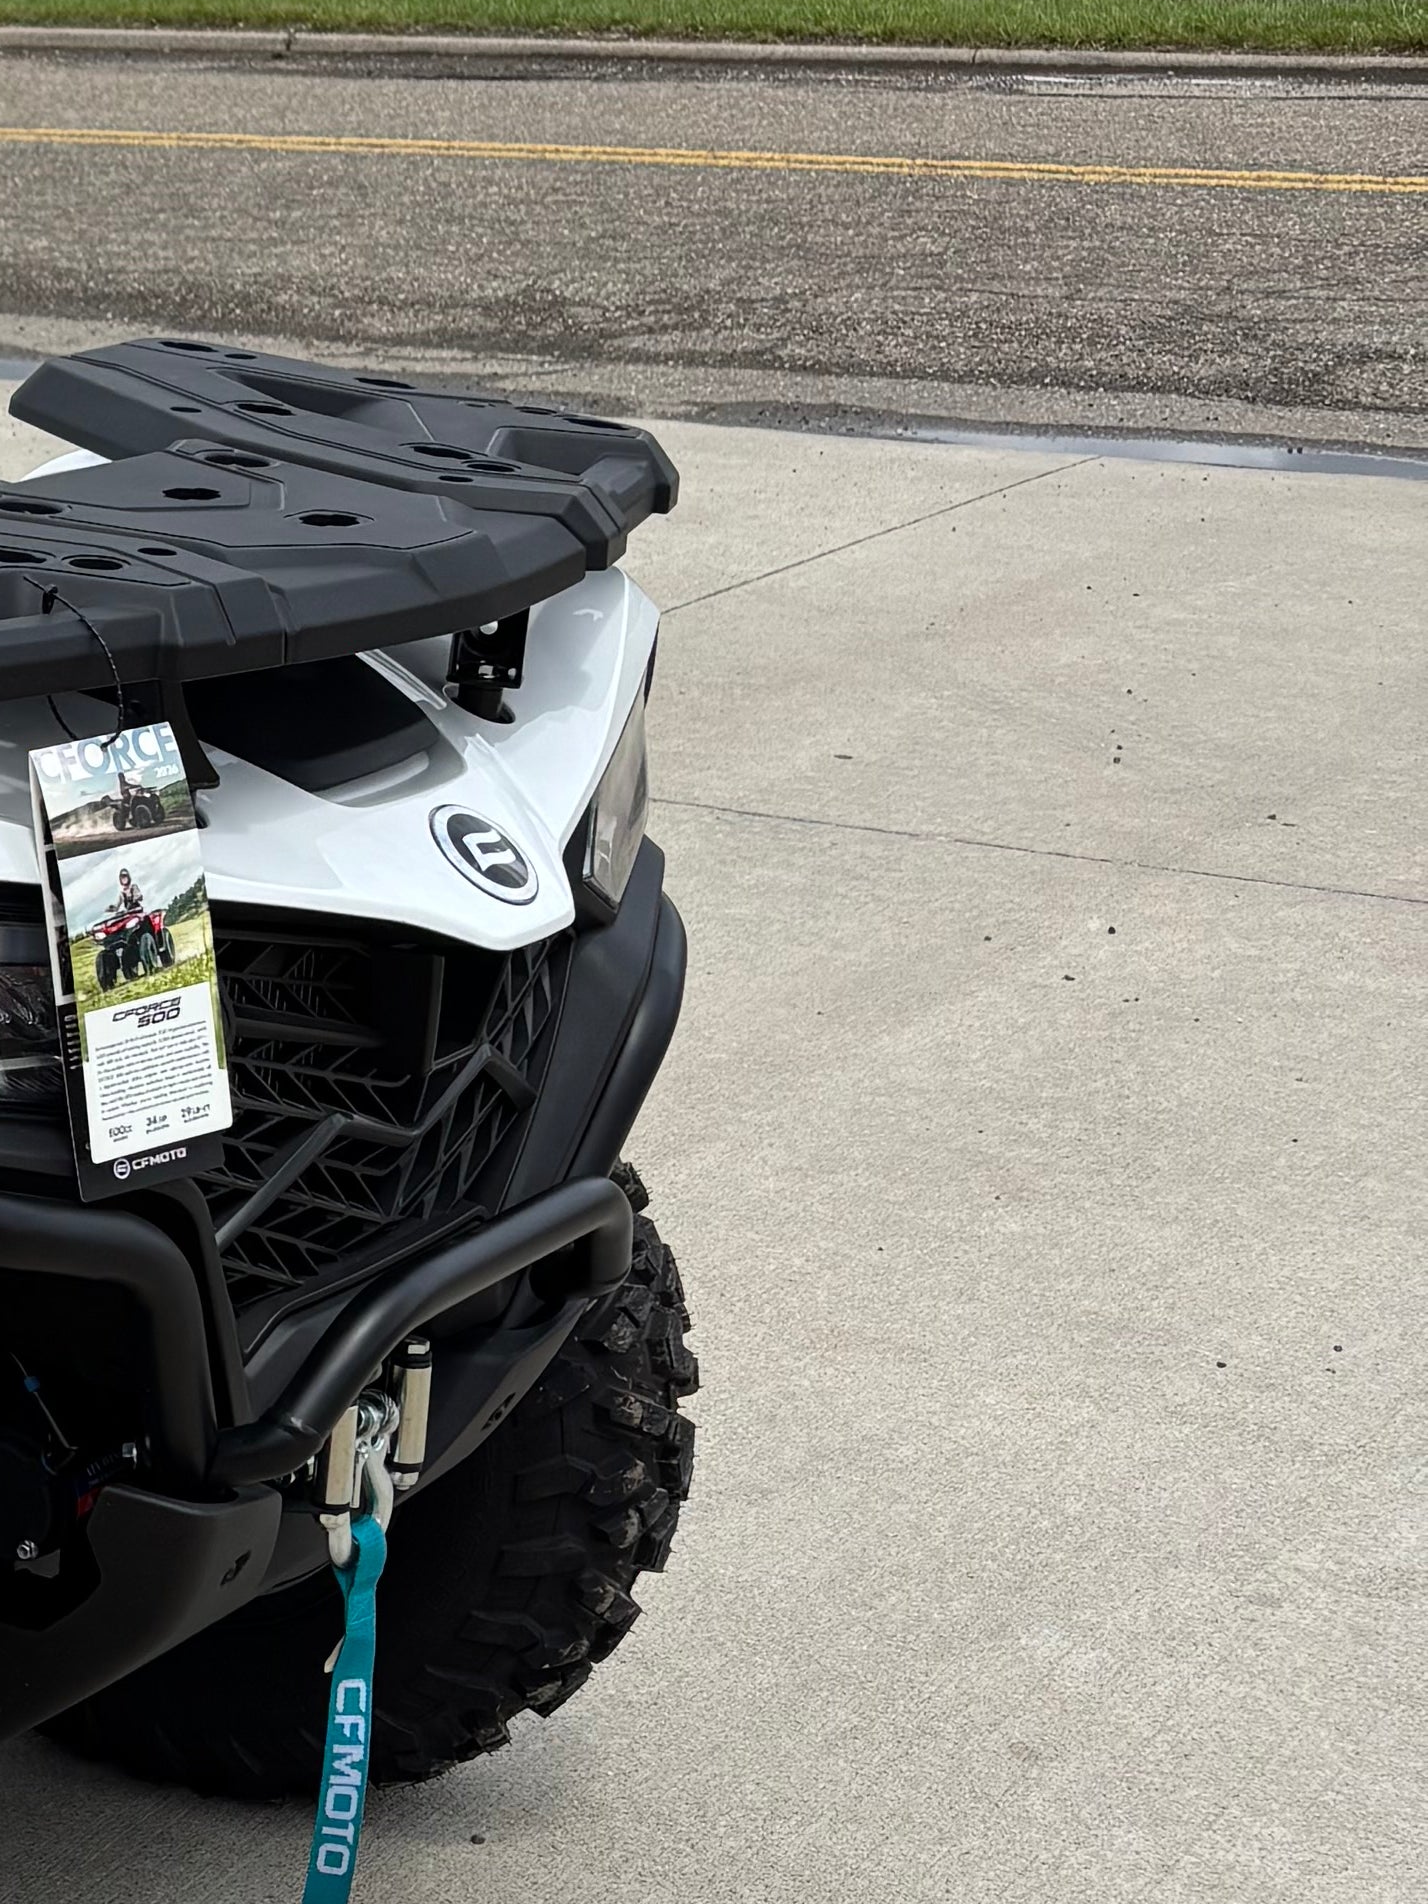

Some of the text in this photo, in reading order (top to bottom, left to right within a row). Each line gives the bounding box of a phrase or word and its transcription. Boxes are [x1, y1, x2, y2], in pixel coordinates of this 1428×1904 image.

[36, 724, 181, 785] CFORCE
[137, 1007, 181, 1028] 500
[132, 1147, 188, 1170] CFMOTO
[316, 1678, 367, 1876] CFMOTO
